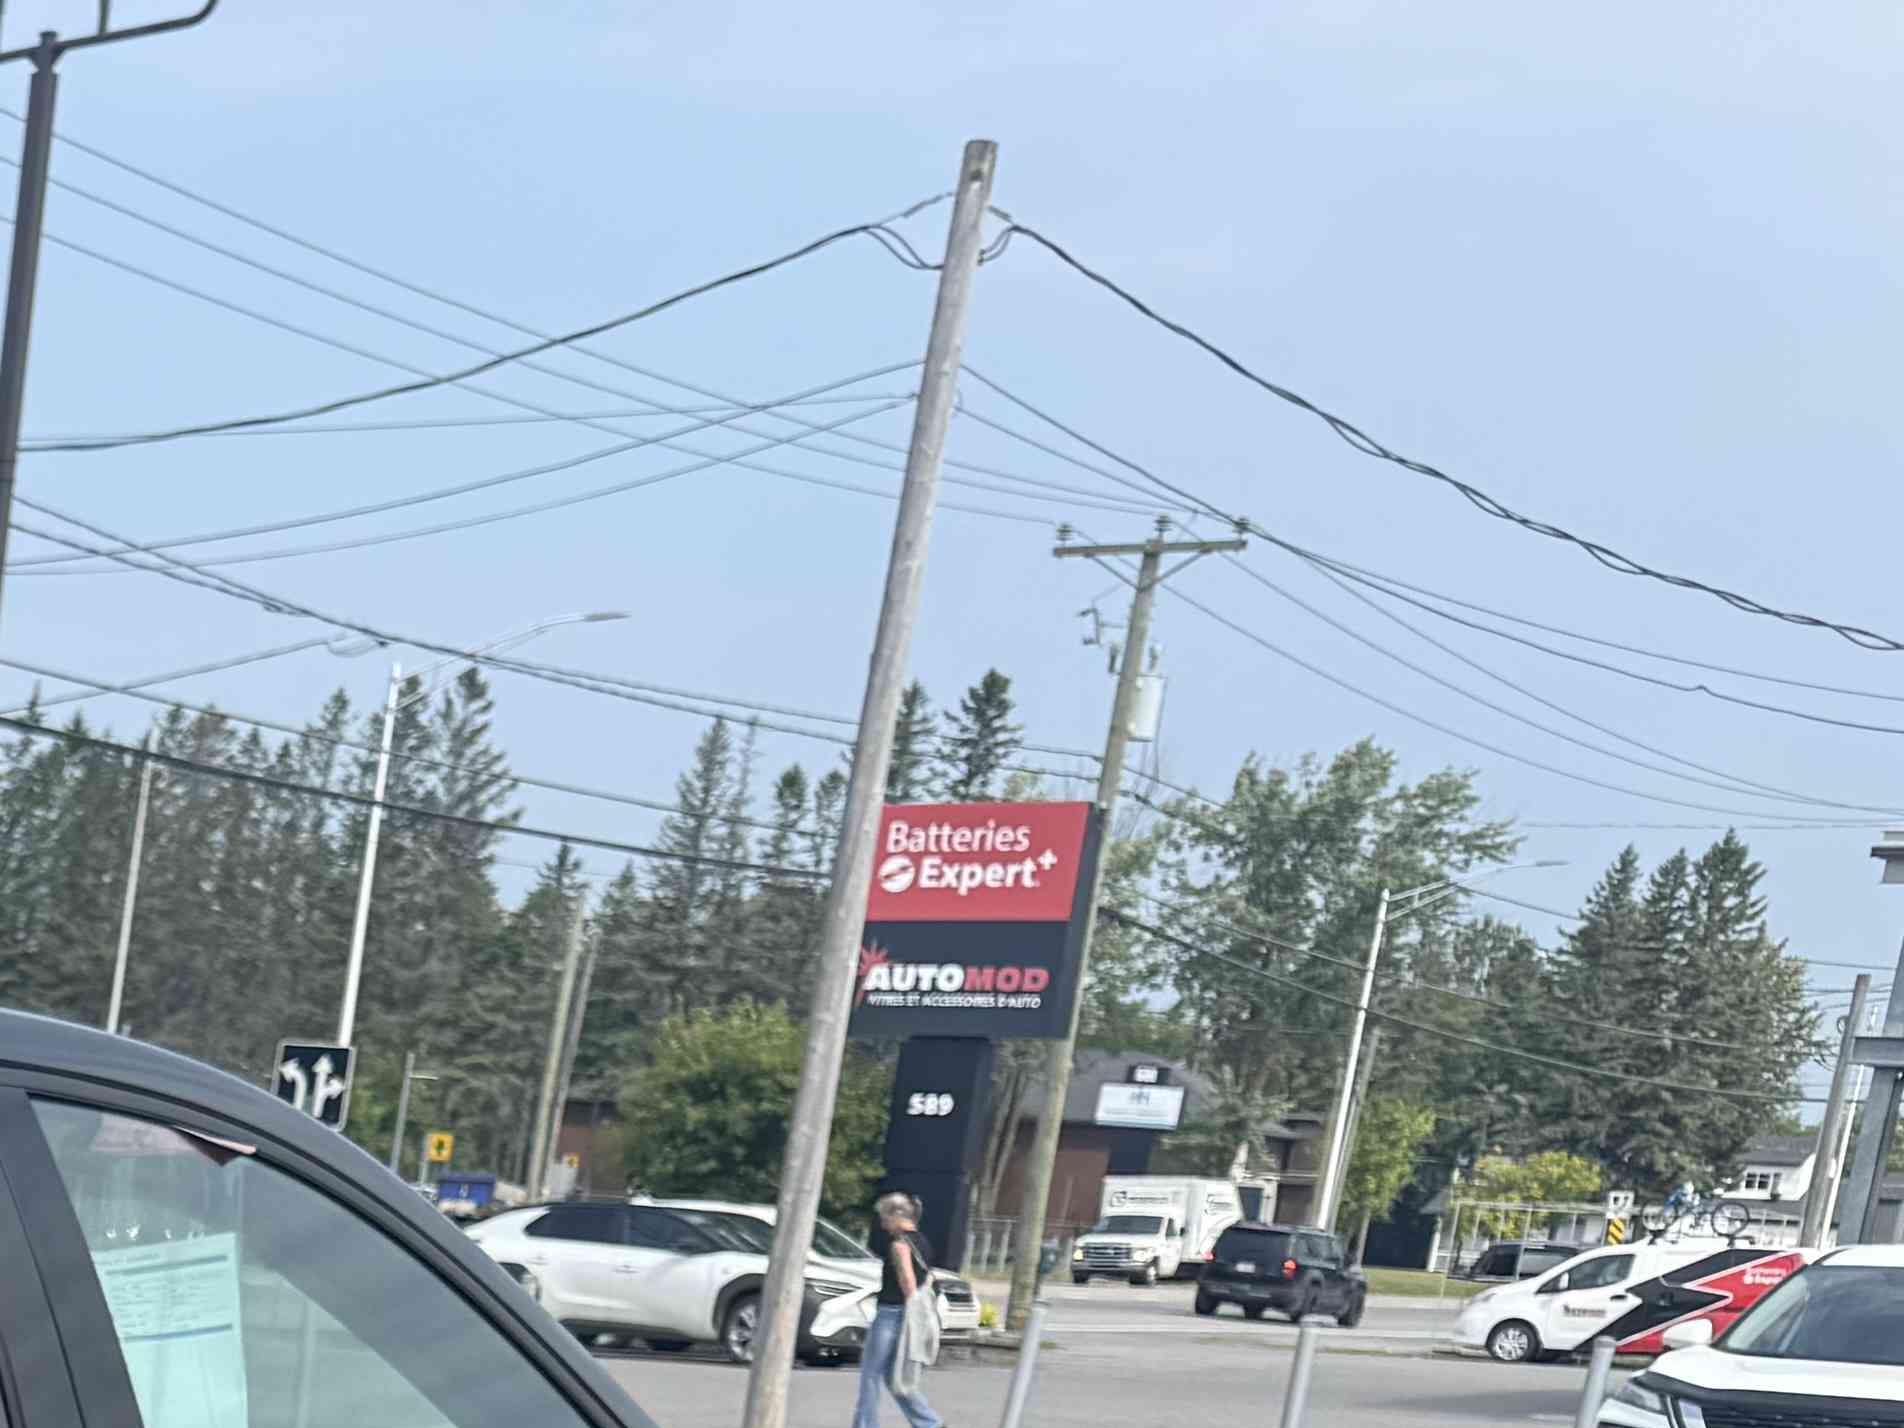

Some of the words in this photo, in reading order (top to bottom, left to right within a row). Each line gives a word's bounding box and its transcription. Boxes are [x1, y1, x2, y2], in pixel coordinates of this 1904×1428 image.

[886, 818, 1032, 853] Batteries
[863, 963, 1050, 992] AUTOMOD
[906, 1092, 955, 1116] 589
